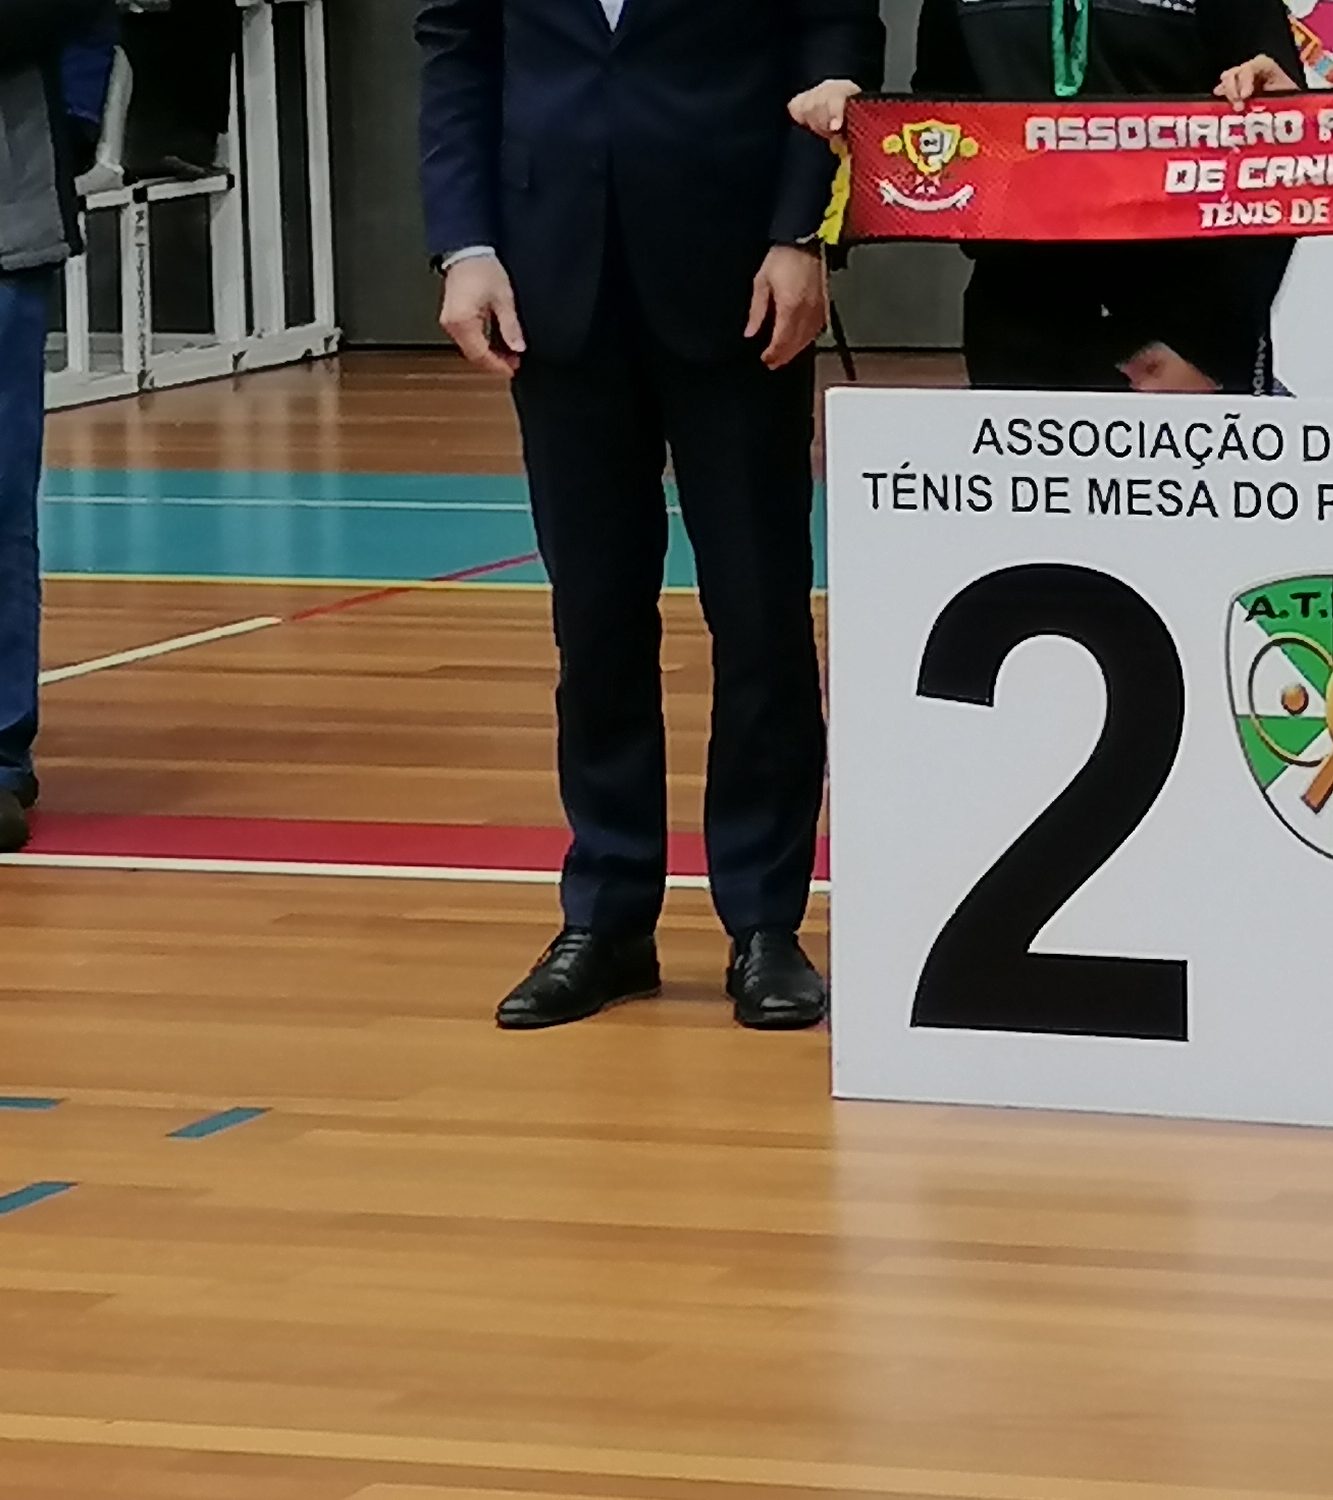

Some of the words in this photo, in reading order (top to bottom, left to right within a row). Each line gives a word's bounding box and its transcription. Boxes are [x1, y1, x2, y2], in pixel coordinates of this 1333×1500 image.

[1025, 105, 1305, 155] ASSOCIAÇÃO
[1165, 158, 1227, 194] DE
[1200, 194, 1282, 229] TÉNIS
[1290, 197, 1329, 226] DE
[972, 413, 1285, 469] ASSOCIAÇÃO
[862, 462, 993, 513] TÉNIS
[1011, 475, 1071, 515] DE
[1087, 479, 1219, 519] MESA
[1234, 482, 1300, 521] DO
[910, 562, 1189, 1042] 2
